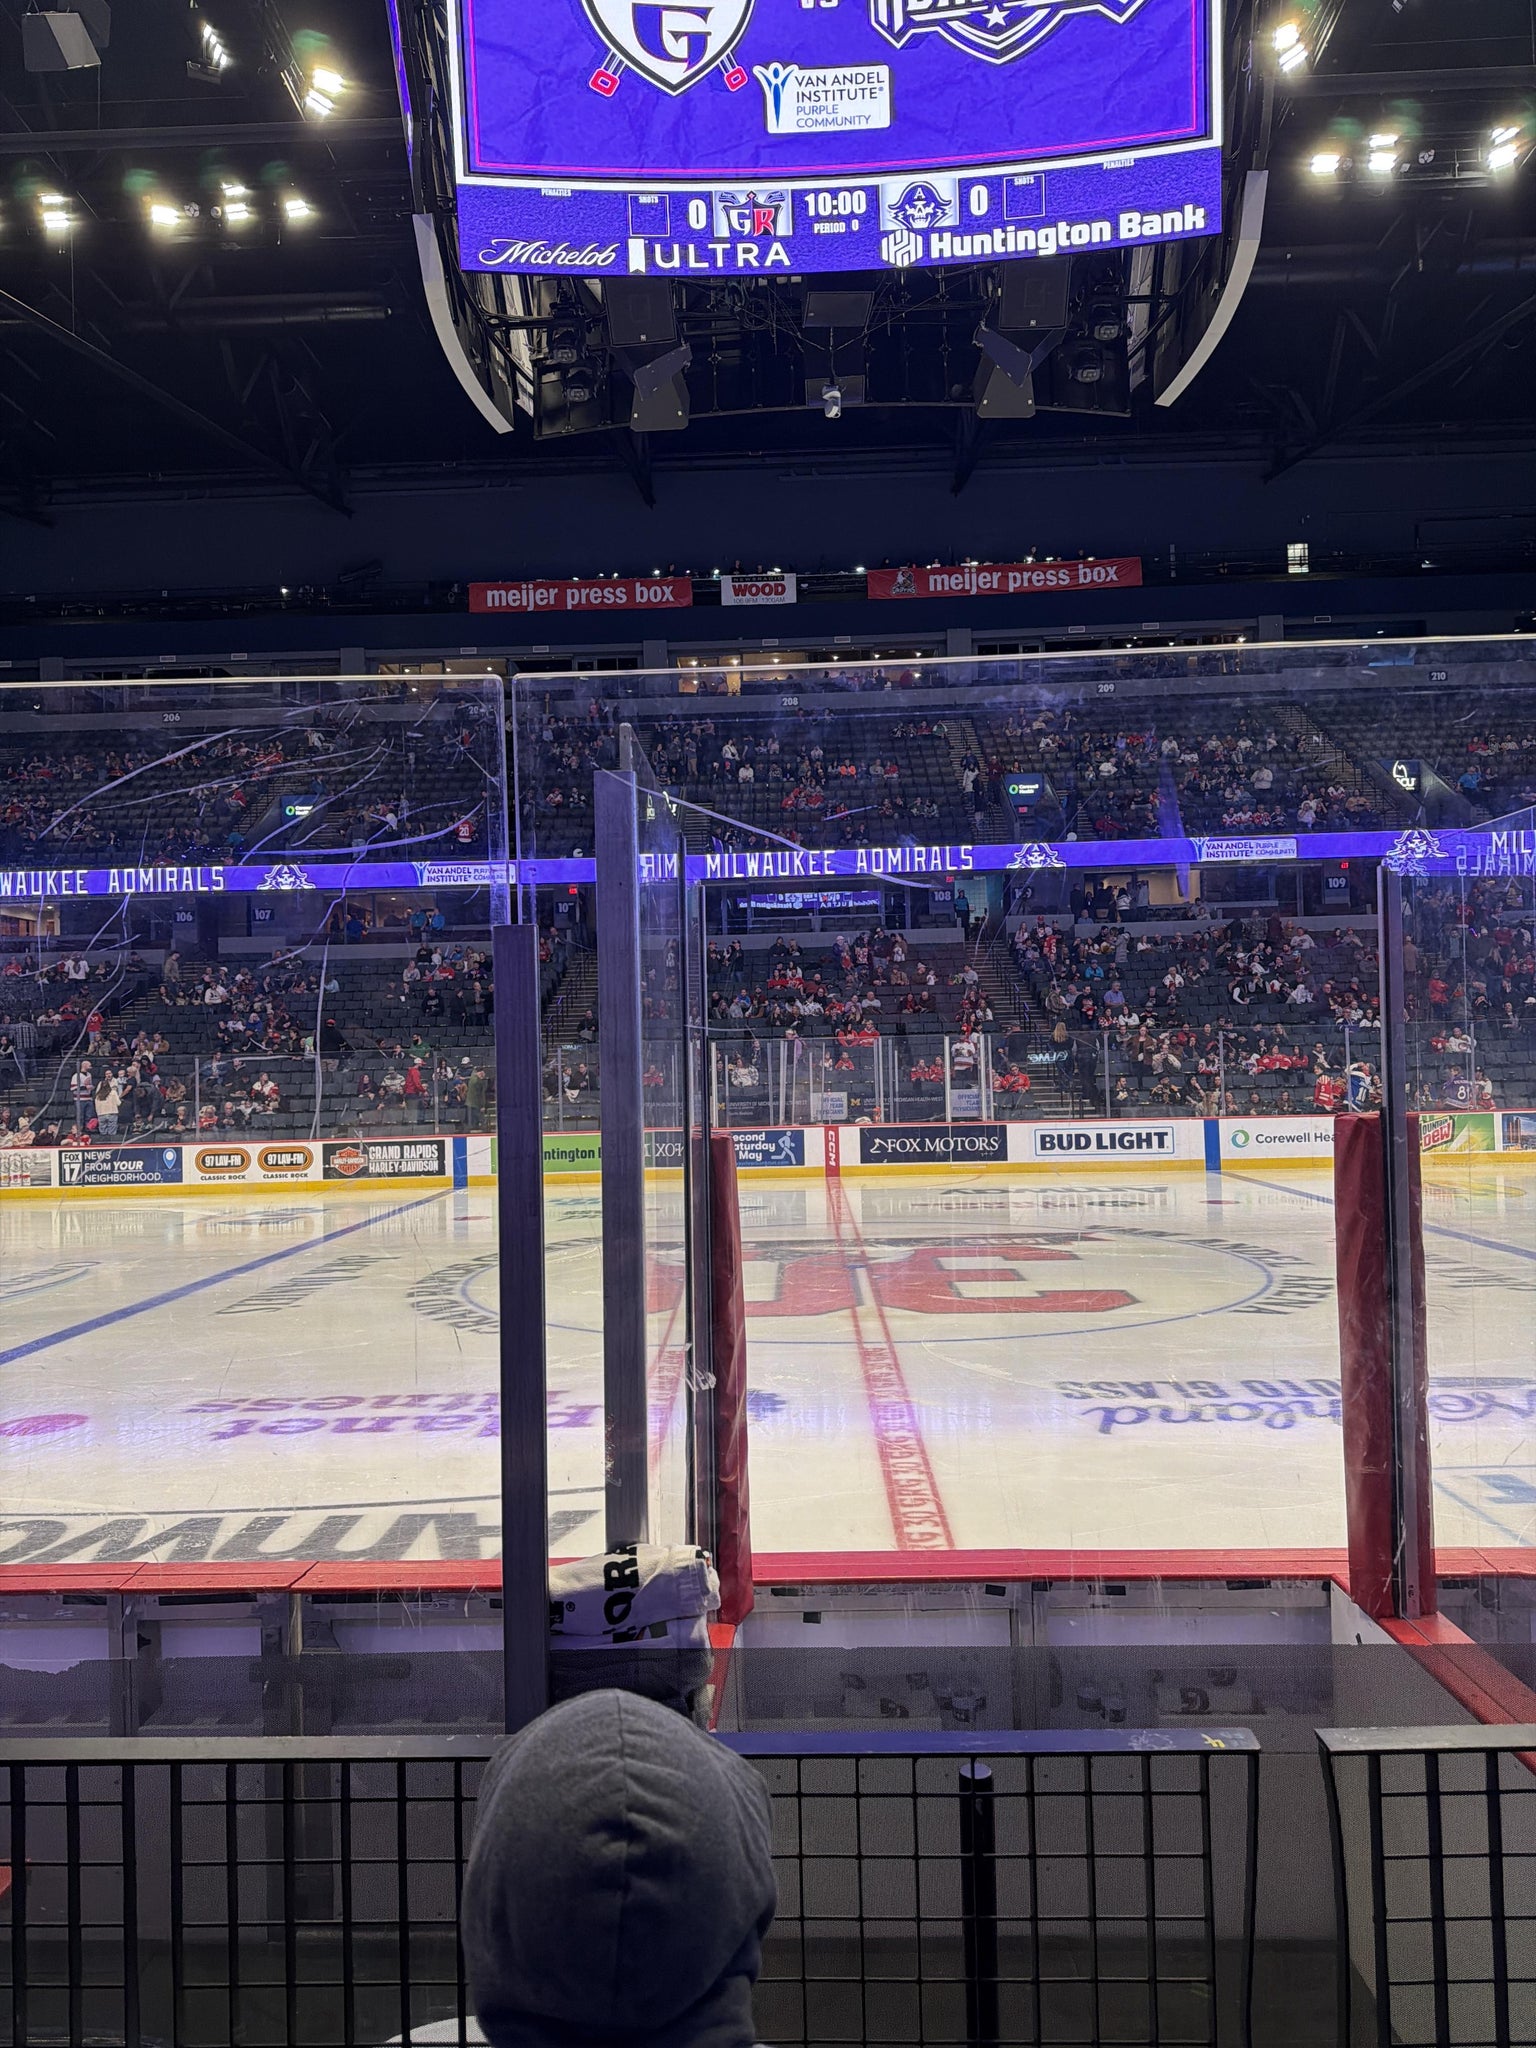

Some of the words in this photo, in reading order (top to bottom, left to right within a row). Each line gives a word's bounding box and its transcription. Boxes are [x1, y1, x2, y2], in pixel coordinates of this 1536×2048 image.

[794, 75, 826, 88] VAN
[830, 71, 885, 87] ANDEL
[796, 104, 839, 116] PURPLE
[796, 115, 872, 129] COMMUNITY
[804, 189, 867, 218] 10:00
[969, 184, 989, 217] 0
[688, 199, 708, 230] 0
[813, 221, 846, 235] PERIOD
[851, 219, 860, 231] 0
[930, 219, 1112, 260] Huntington
[1119, 204, 1206, 240] Bank
[478, 238, 621, 267] Michelob
[654, 241, 792, 270] ULTRA
[928, 567, 1002, 595] meijer
[1008, 568, 1070, 593] press
[1077, 563, 1119, 584] box
[486, 583, 559, 612] meijer
[566, 586, 628, 610] press
[635, 582, 675, 604] box
[731, 582, 787, 598] WOOD
[1430, 671, 1447, 681] 210
[1097, 683, 1115, 693] 209
[782, 696, 799, 706] 208
[162, 712, 181, 723] 206
[1205, 842, 1224, 851] VAN
[1224, 841, 1254, 850] ANDEL
[706, 850, 837, 879] MILWAUKEE
[856, 845, 974, 874] ADMIRALS
[426, 867, 443, 875] VAN
[444, 866, 472, 875] ANDEL
[108, 866, 224, 893] ADMIRALS
[1327, 877, 1346, 889] 109
[933, 891, 951, 902] 108
[1014, 888, 1032, 899] 19
[175, 911, 193, 922] 106
[254, 909, 272, 920] 107
[887, 1138, 922, 1153] FOX
[924, 1136, 999, 1152] MOTORS
[1040, 1133, 1092, 1151] BUD
[1095, 1131, 1169, 1151] LIGHT
[1255, 1132, 1311, 1144] Corewell
[84, 1151, 112, 1160] NEWS
[368, 1146, 402, 1160] GRAND
[404, 1144, 439, 1159] RAPIDS
[738, 1150, 763, 1162] May
[827, 1130, 838, 1167] CCM
[63, 1152, 81, 1162] FOX
[63, 1162, 82, 1183] 17
[84, 1162, 112, 1171] FROM
[113, 1160, 144, 1171] YOUR
[368, 1160, 439, 1174] HARLEY-DAVIDSON
[84, 1172, 164, 1183] NEIGHBORHOOD.
[1228, 1273, 1335, 1316] ARENA
[1054, 1380, 1229, 1401] GLASS
[1240, 1378, 1341, 1399] UTO
